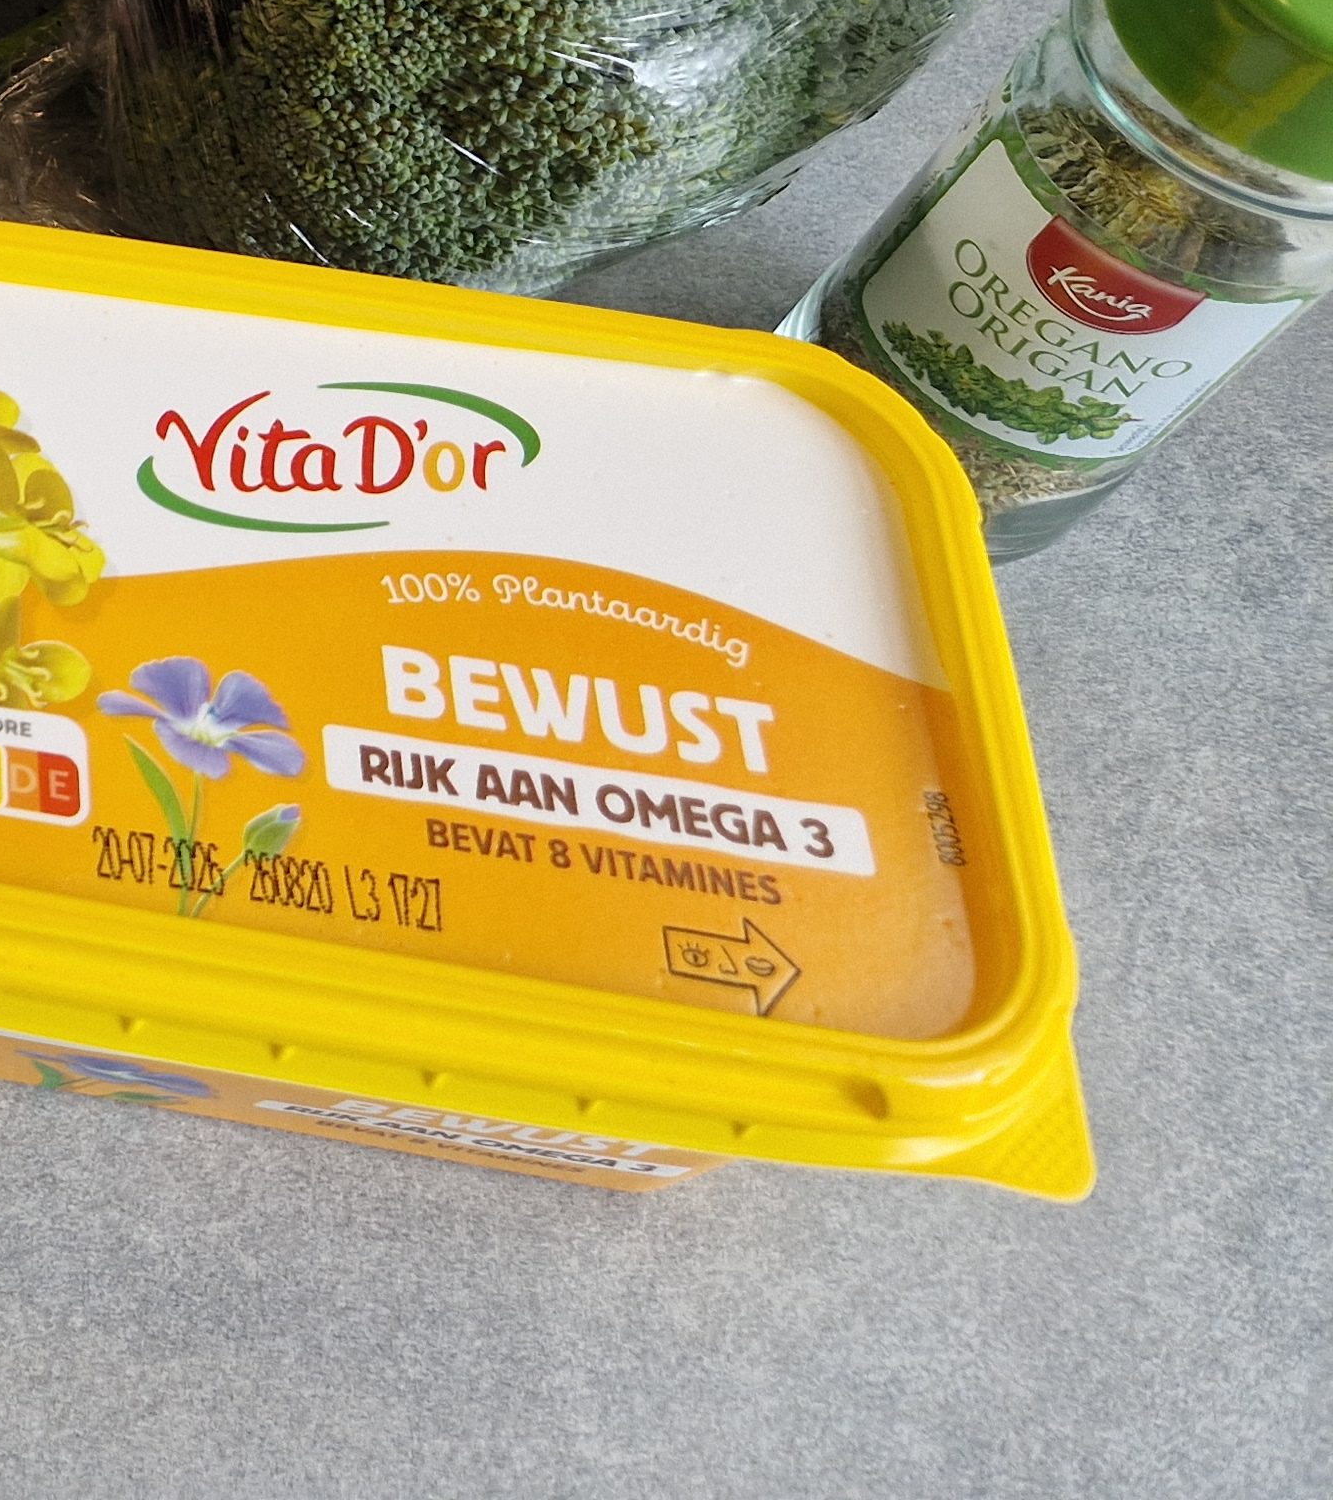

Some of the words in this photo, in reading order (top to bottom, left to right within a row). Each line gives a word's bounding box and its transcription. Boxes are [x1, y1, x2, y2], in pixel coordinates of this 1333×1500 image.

[947, 279, 1148, 400] ORIGAN
[954, 238, 1193, 379] OREGANO
[379, 571, 481, 605] 100%
[493, 574, 751, 668] Plantaardig
[381, 644, 774, 773] BEWUST
[359, 745, 459, 797] RIJK
[475, 764, 579, 818] AAN
[595, 782, 788, 853] OMEGA
[801, 817, 835, 859] 3
[92, 826, 226, 896] 20-07-2026
[345, 866, 381, 923] L3
[426, 818, 536, 865] BEVAT
[549, 839, 572, 869] 8
[580, 843, 781, 907] VITAMINES
[283, 1105, 365, 1122] RIJK
[375, 1121, 462, 1140] AAN
[471, 1139, 617, 1167] OMEGA
[331, 1099, 672, 1157] BEWUST
